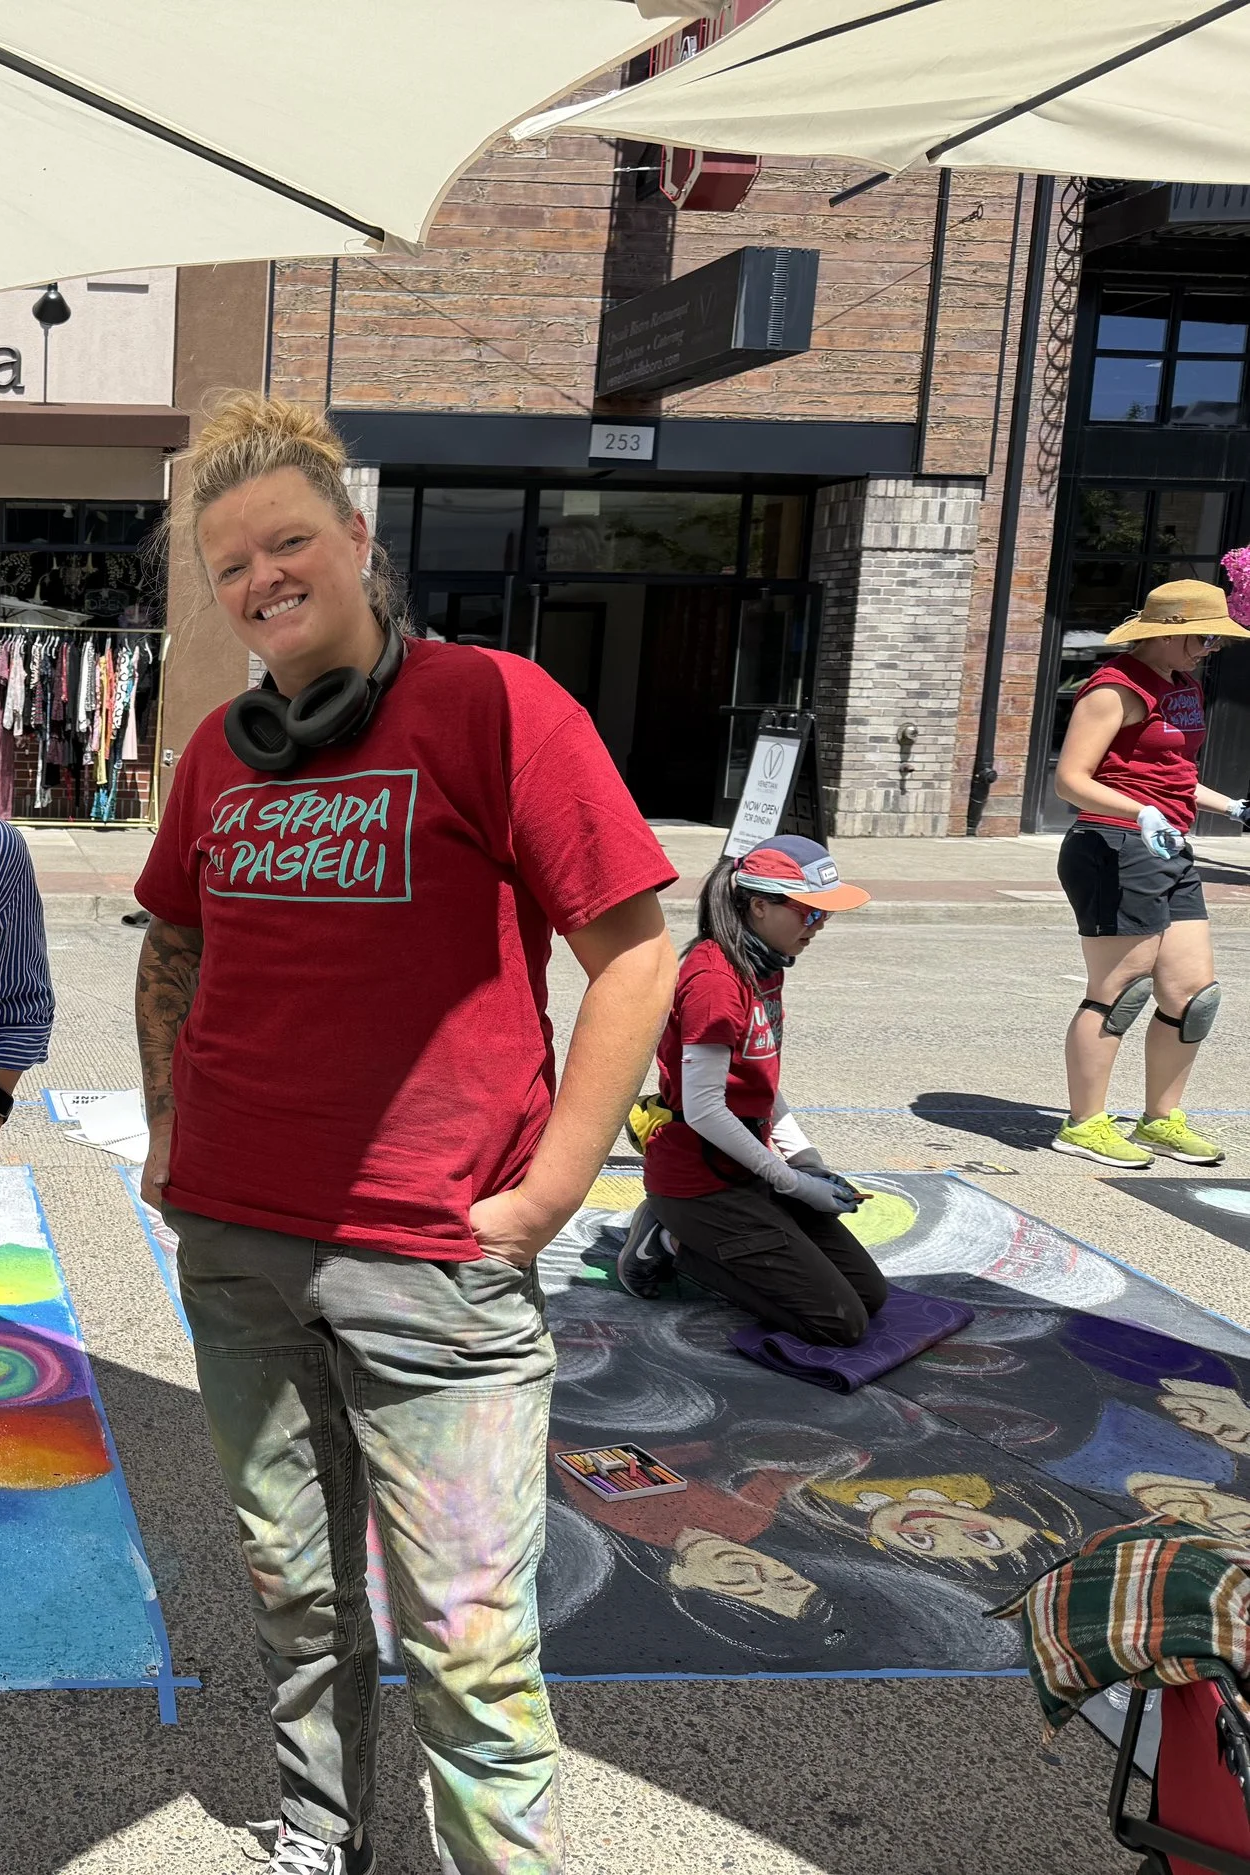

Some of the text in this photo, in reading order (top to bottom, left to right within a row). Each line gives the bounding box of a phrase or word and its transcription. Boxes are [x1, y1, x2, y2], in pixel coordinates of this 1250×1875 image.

[605, 433, 641, 451] 253
[253, 789, 390, 839] STRADA
[743, 800, 780, 815] NOW OPEN
[229, 834, 387, 892] PASTELLI
